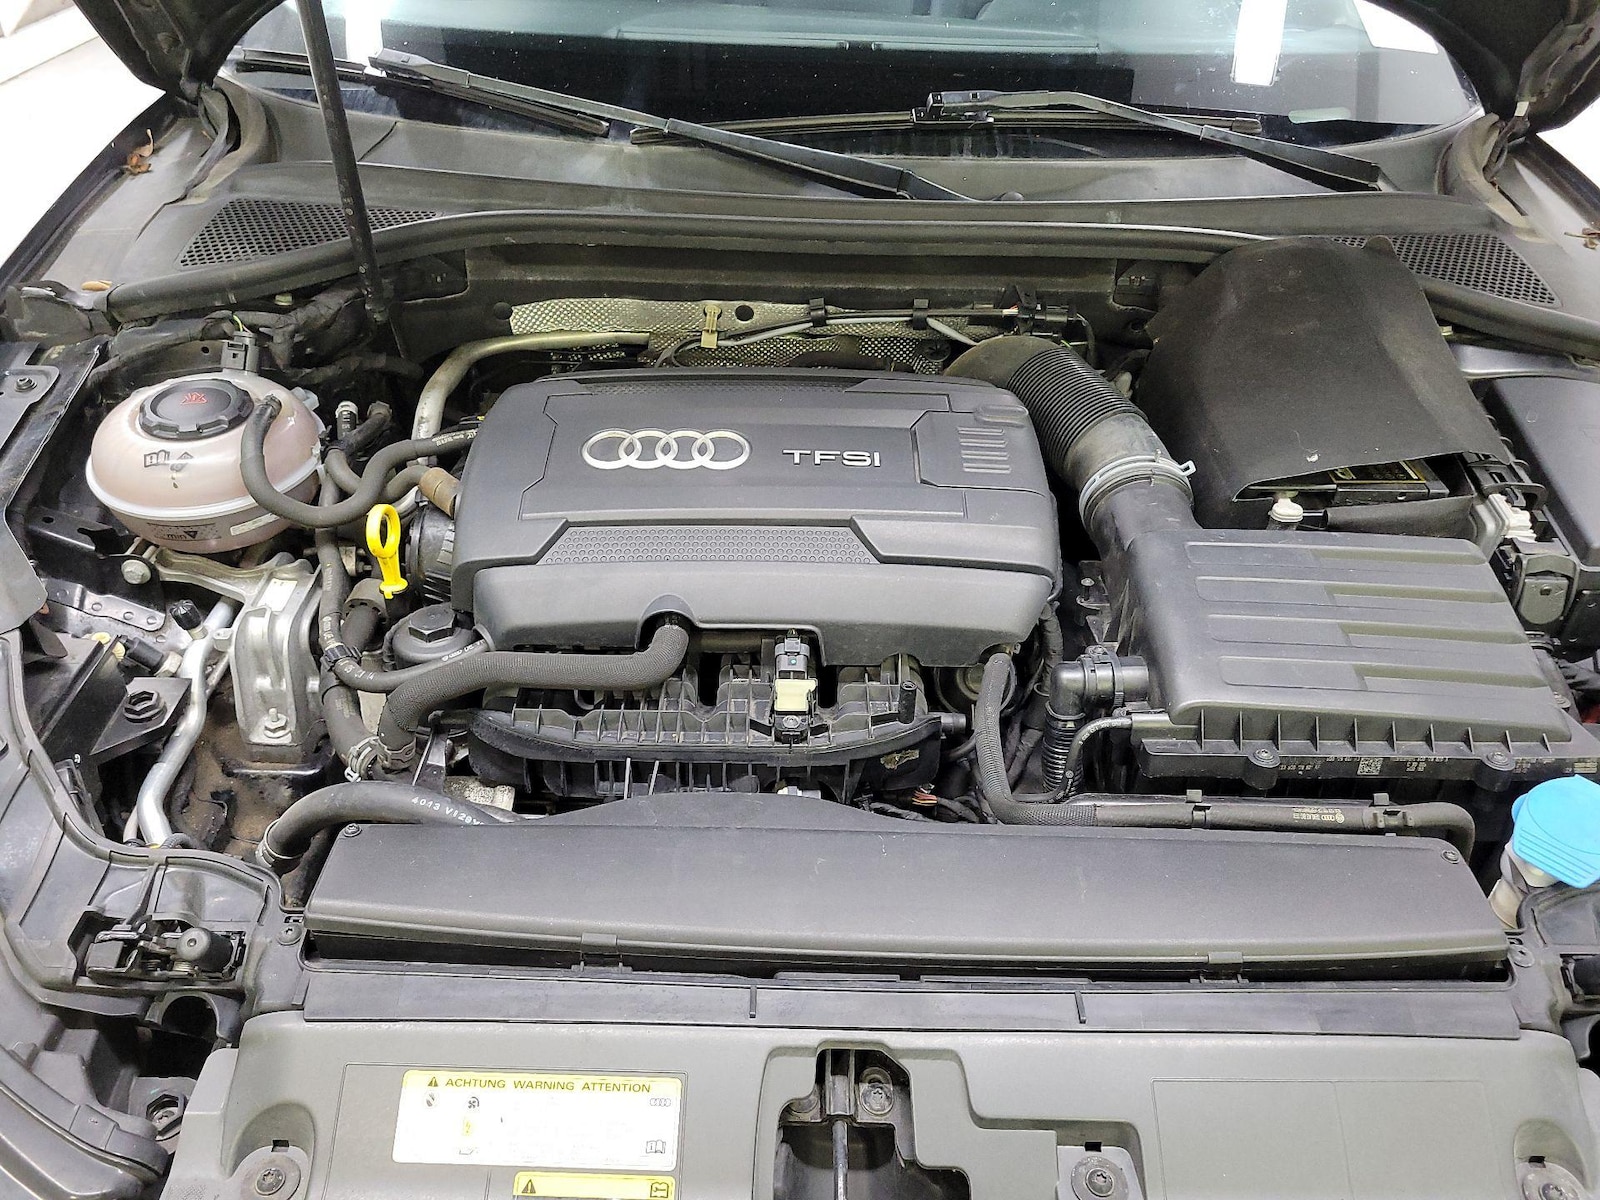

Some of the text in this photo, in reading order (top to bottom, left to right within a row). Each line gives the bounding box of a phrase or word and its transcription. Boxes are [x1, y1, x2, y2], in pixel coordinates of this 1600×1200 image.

[782, 449, 881, 467] TFSI
[445, 1078, 651, 1093] ACHTUNG WARNING ATTENTION
